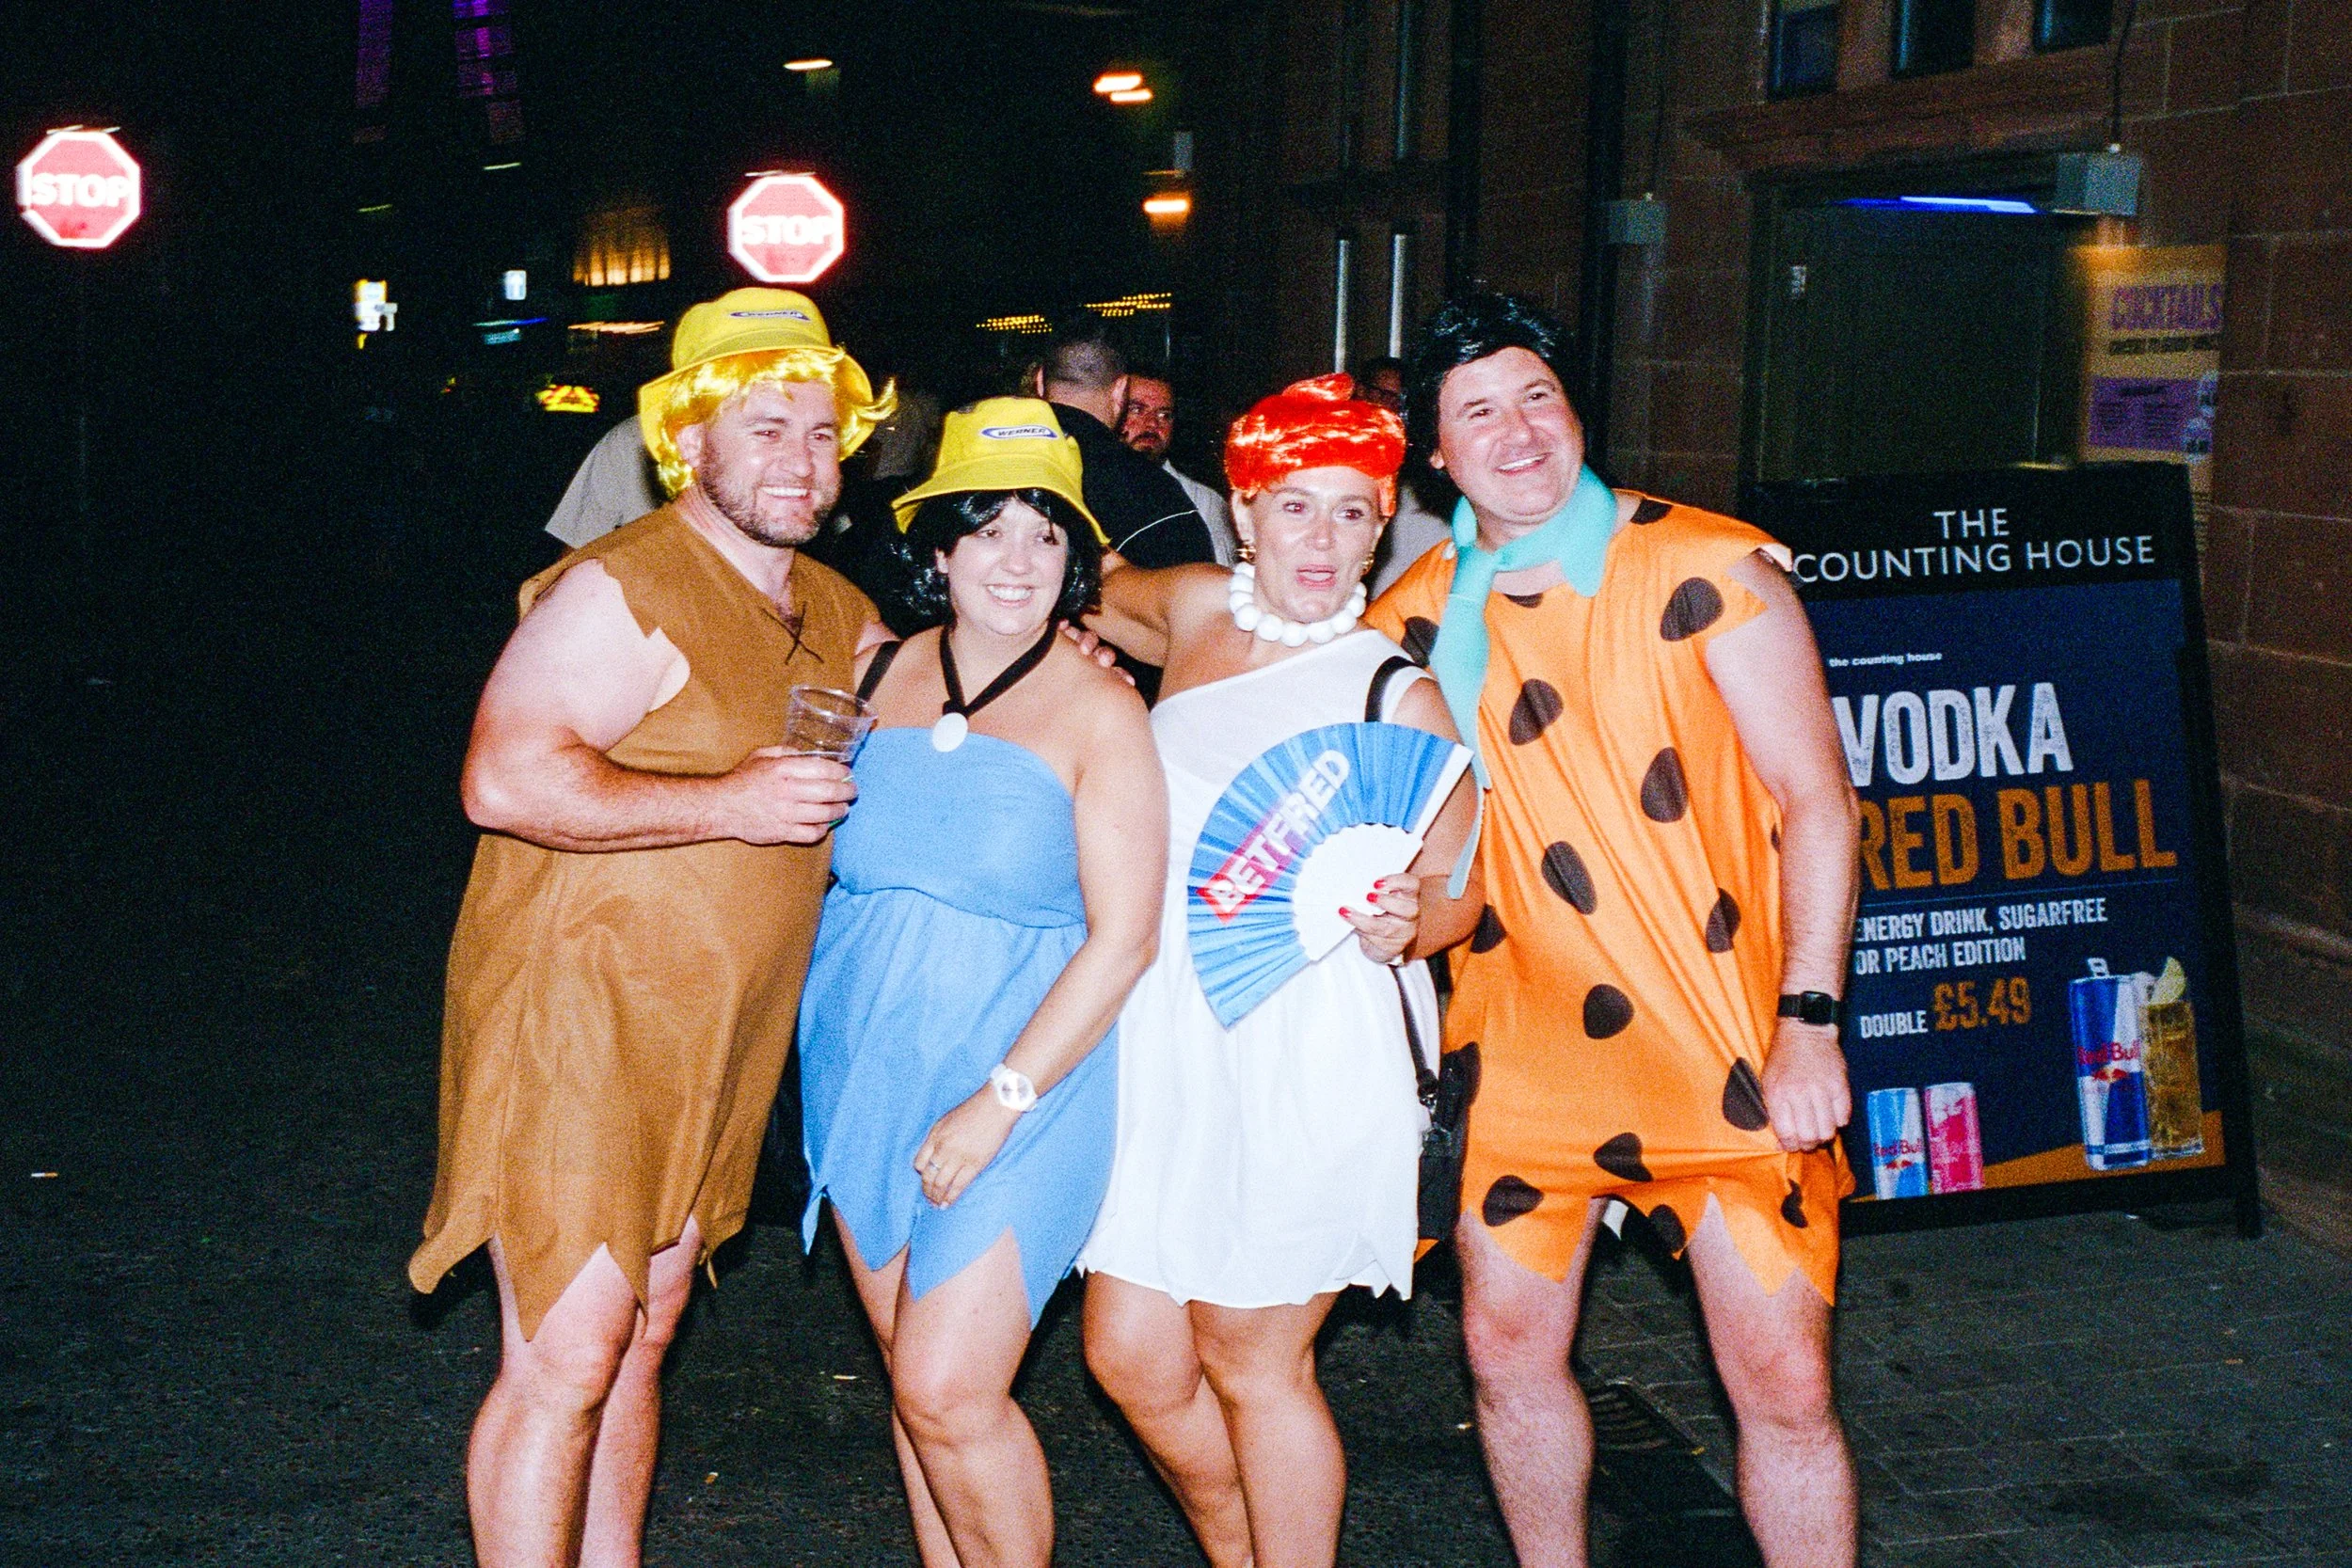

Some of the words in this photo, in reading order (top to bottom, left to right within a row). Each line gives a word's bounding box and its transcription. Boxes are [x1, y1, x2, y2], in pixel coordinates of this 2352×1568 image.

[32, 173, 131, 208] STOP
[741, 214, 835, 245] STOP
[1933, 508, 2010, 539] THE
[1793, 544, 2011, 583] COUNTING
[2026, 535, 2155, 570] HOUSE
[1828, 657, 1850, 667] the
[1851, 655, 1905, 665] counting
[1906, 652, 1943, 662] house
[1832, 682, 2074, 786] VODKA
[1201, 750, 1351, 913] BETFRED
[1860, 793, 1979, 890] RED
[1998, 779, 2178, 880] BULL
[1931, 907, 1993, 936] DRINK,
[1997, 897, 2108, 930] SUGARFREE
[1855, 949, 1881, 975] OR
[1884, 943, 1948, 973] PEACH
[1952, 937, 2026, 967] EDITION
[1860, 1009, 1929, 1038] DOUBLE
[1933, 975, 2031, 1031] £5.49
